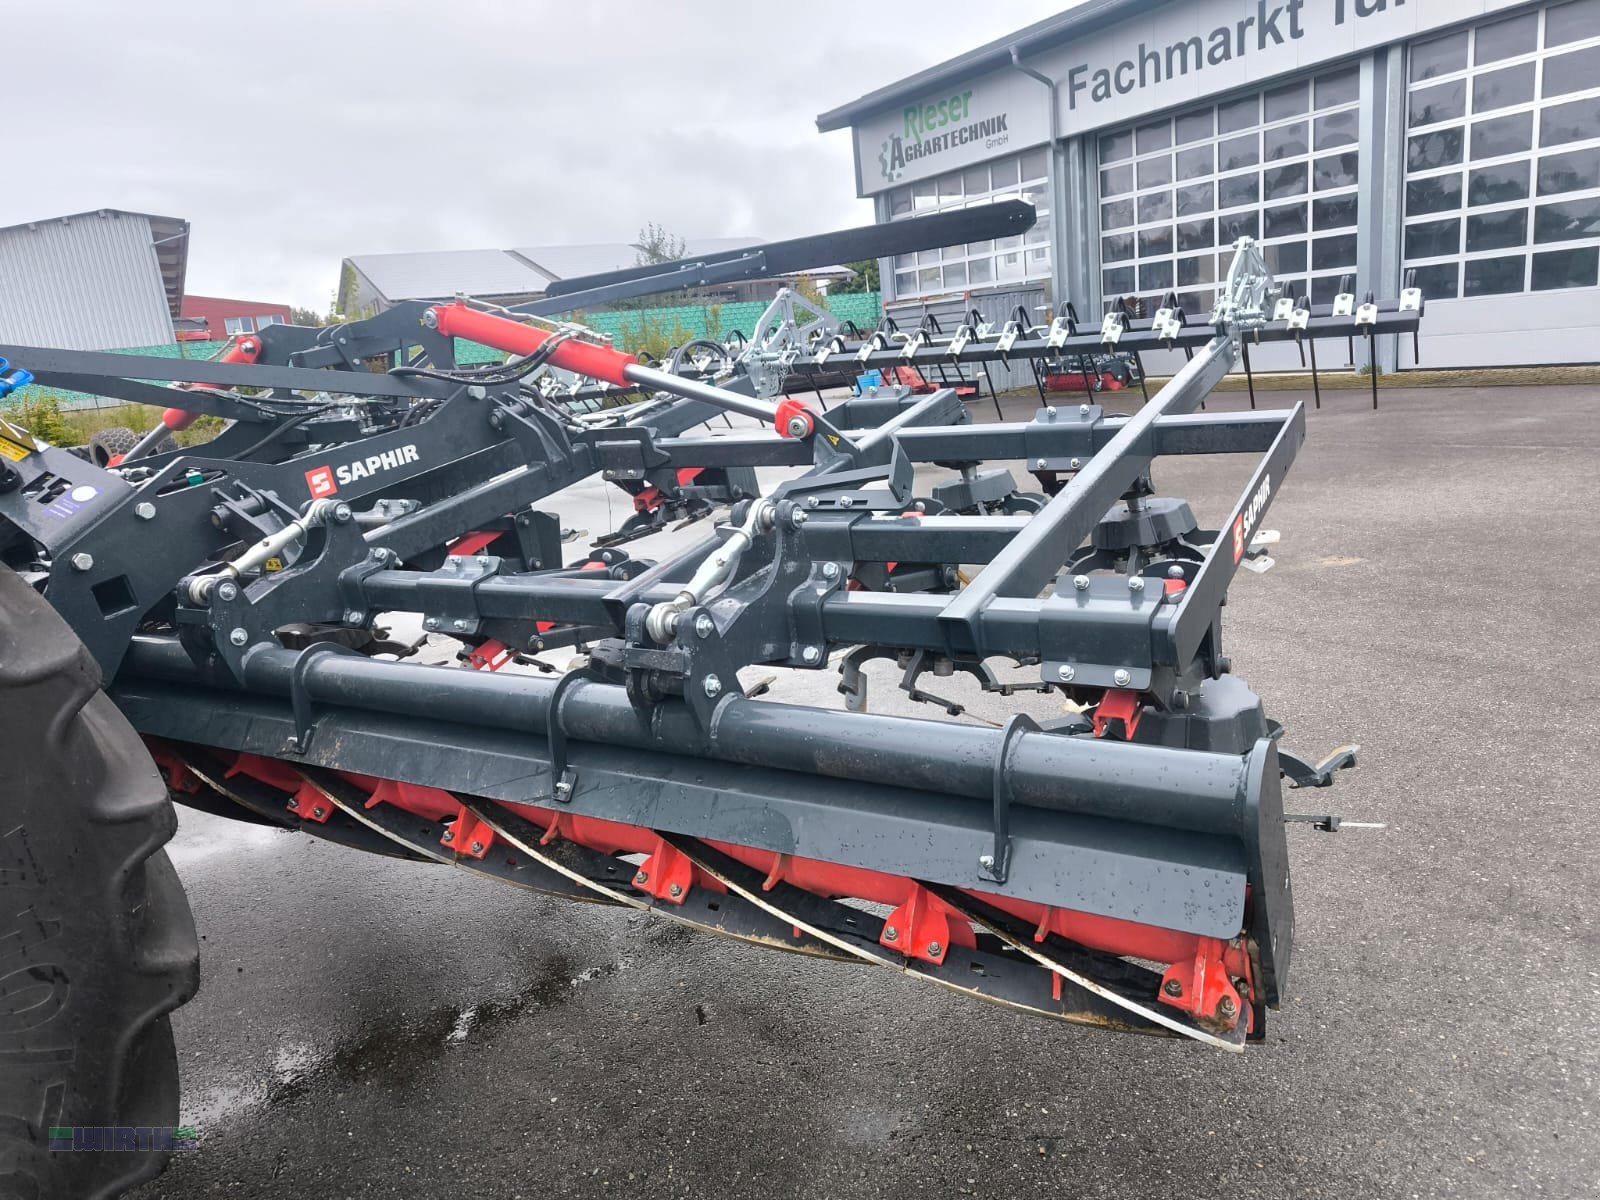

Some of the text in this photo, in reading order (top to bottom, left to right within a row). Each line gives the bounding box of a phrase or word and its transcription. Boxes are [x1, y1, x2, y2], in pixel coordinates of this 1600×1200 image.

[1069, 0, 1304, 110] Fachmarkt
[890, 113, 1008, 171] AGRARTECHNIK
[985, 135, 1009, 149] GmbH
[336, 444, 420, 485] SAPHIR
[1243, 473, 1270, 539] SAPHIR
